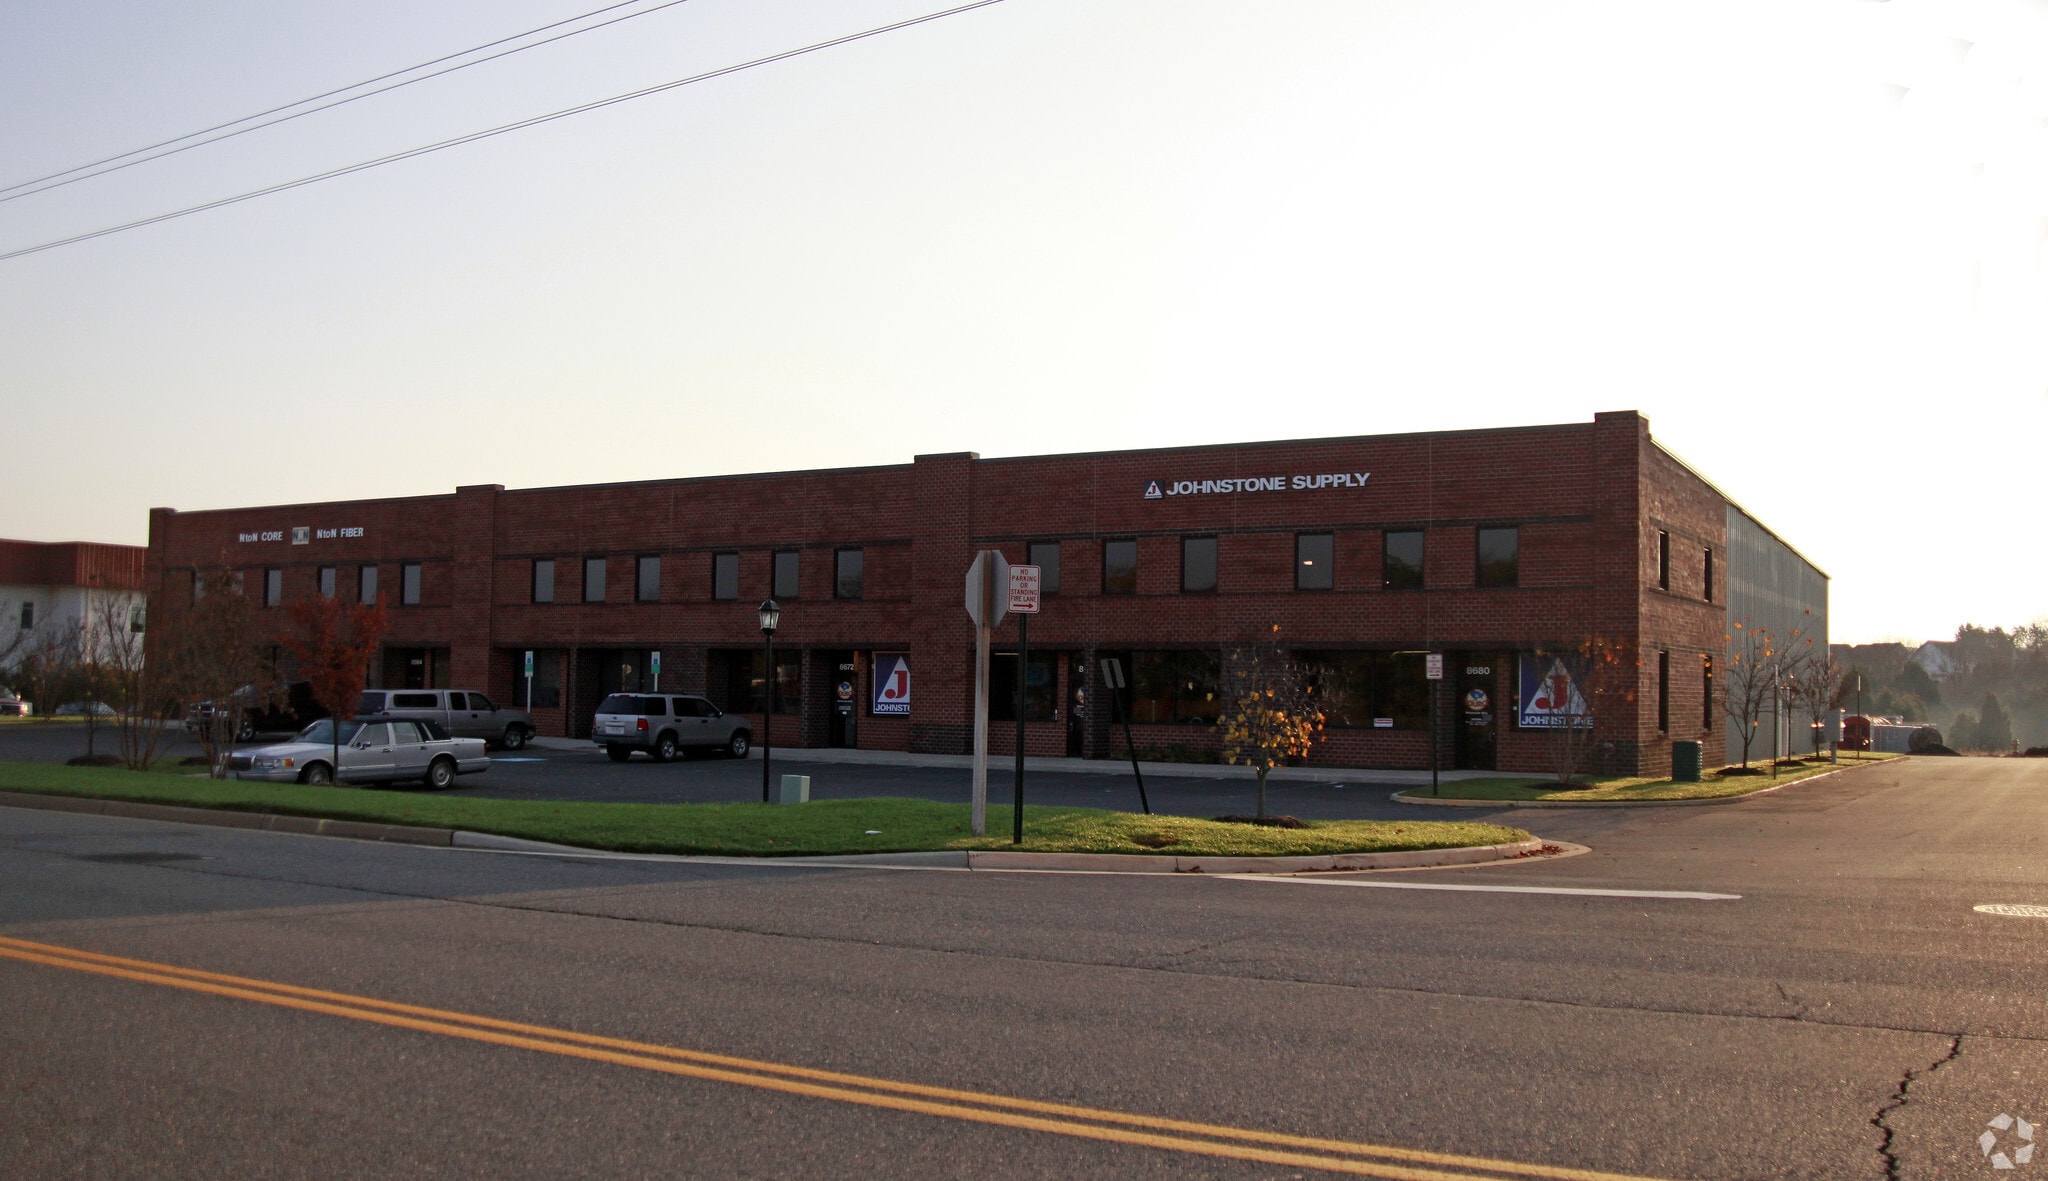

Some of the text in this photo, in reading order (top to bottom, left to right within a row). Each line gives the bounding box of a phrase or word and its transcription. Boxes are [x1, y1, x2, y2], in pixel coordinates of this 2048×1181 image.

[1167, 473, 1370, 496] JOHNSTONE SUPPLY
[239, 531, 283, 542] NtoN CORE
[317, 527, 364, 539] NtoN FIBER
[1466, 666, 1490, 675] 8680
